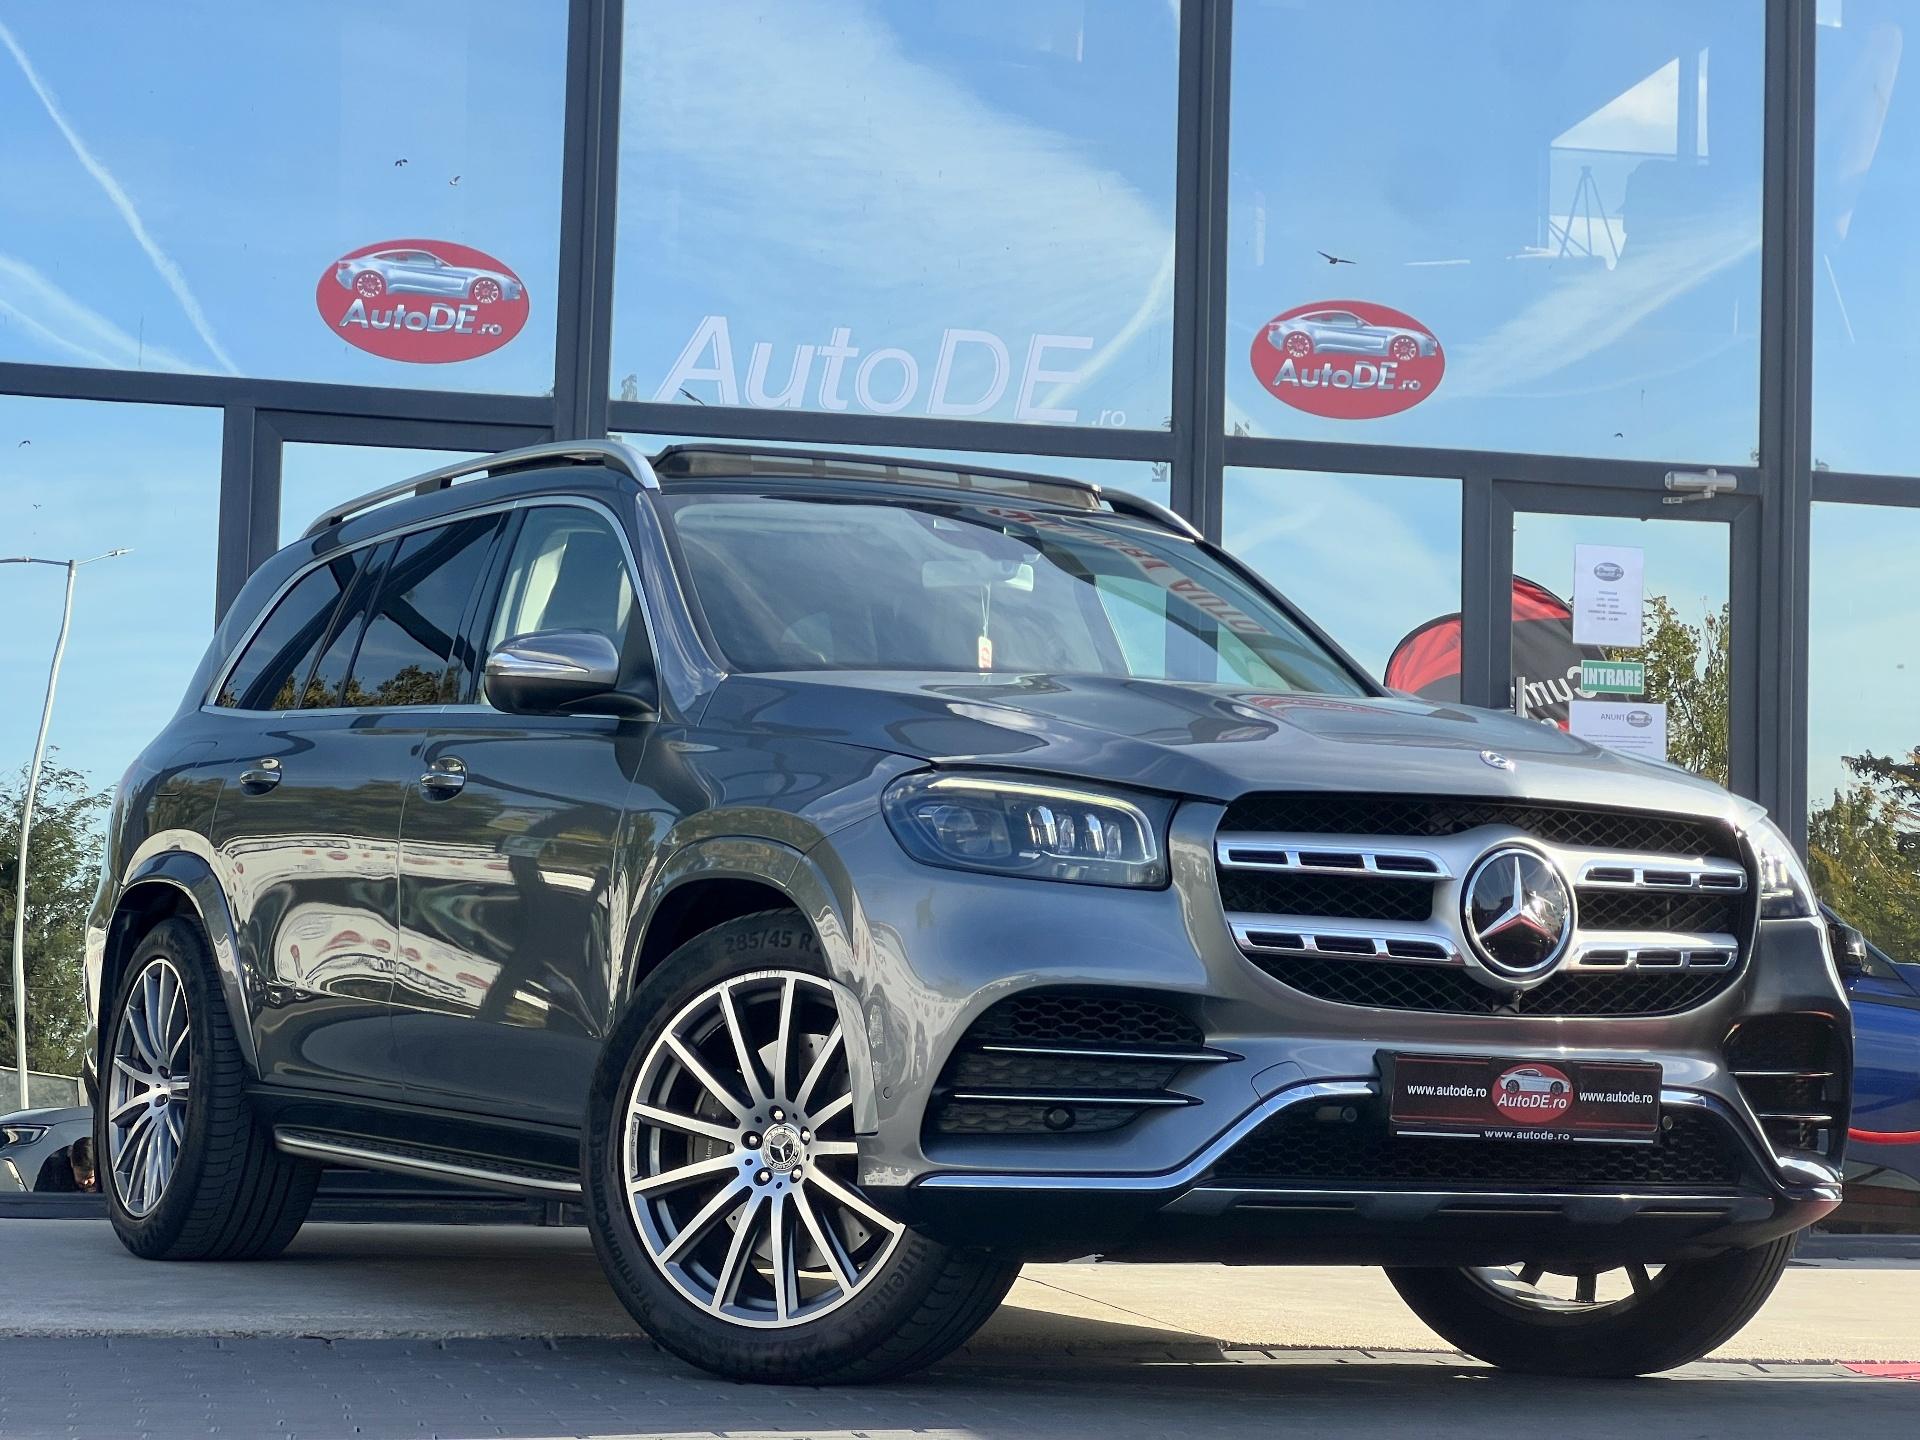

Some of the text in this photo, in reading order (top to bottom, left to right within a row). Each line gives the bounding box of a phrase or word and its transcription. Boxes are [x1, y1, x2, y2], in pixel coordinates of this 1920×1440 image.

[1583, 666, 1642, 687] INTRARE
[724, 929, 792, 955] 285/45
[1407, 1083, 1487, 1098] www.autode.ro
[1579, 1090, 1653, 1104] www.autode.ro
[1497, 1094, 1567, 1110] AutoDE.ro
[1484, 1130, 1570, 1141] www.autode.ro
